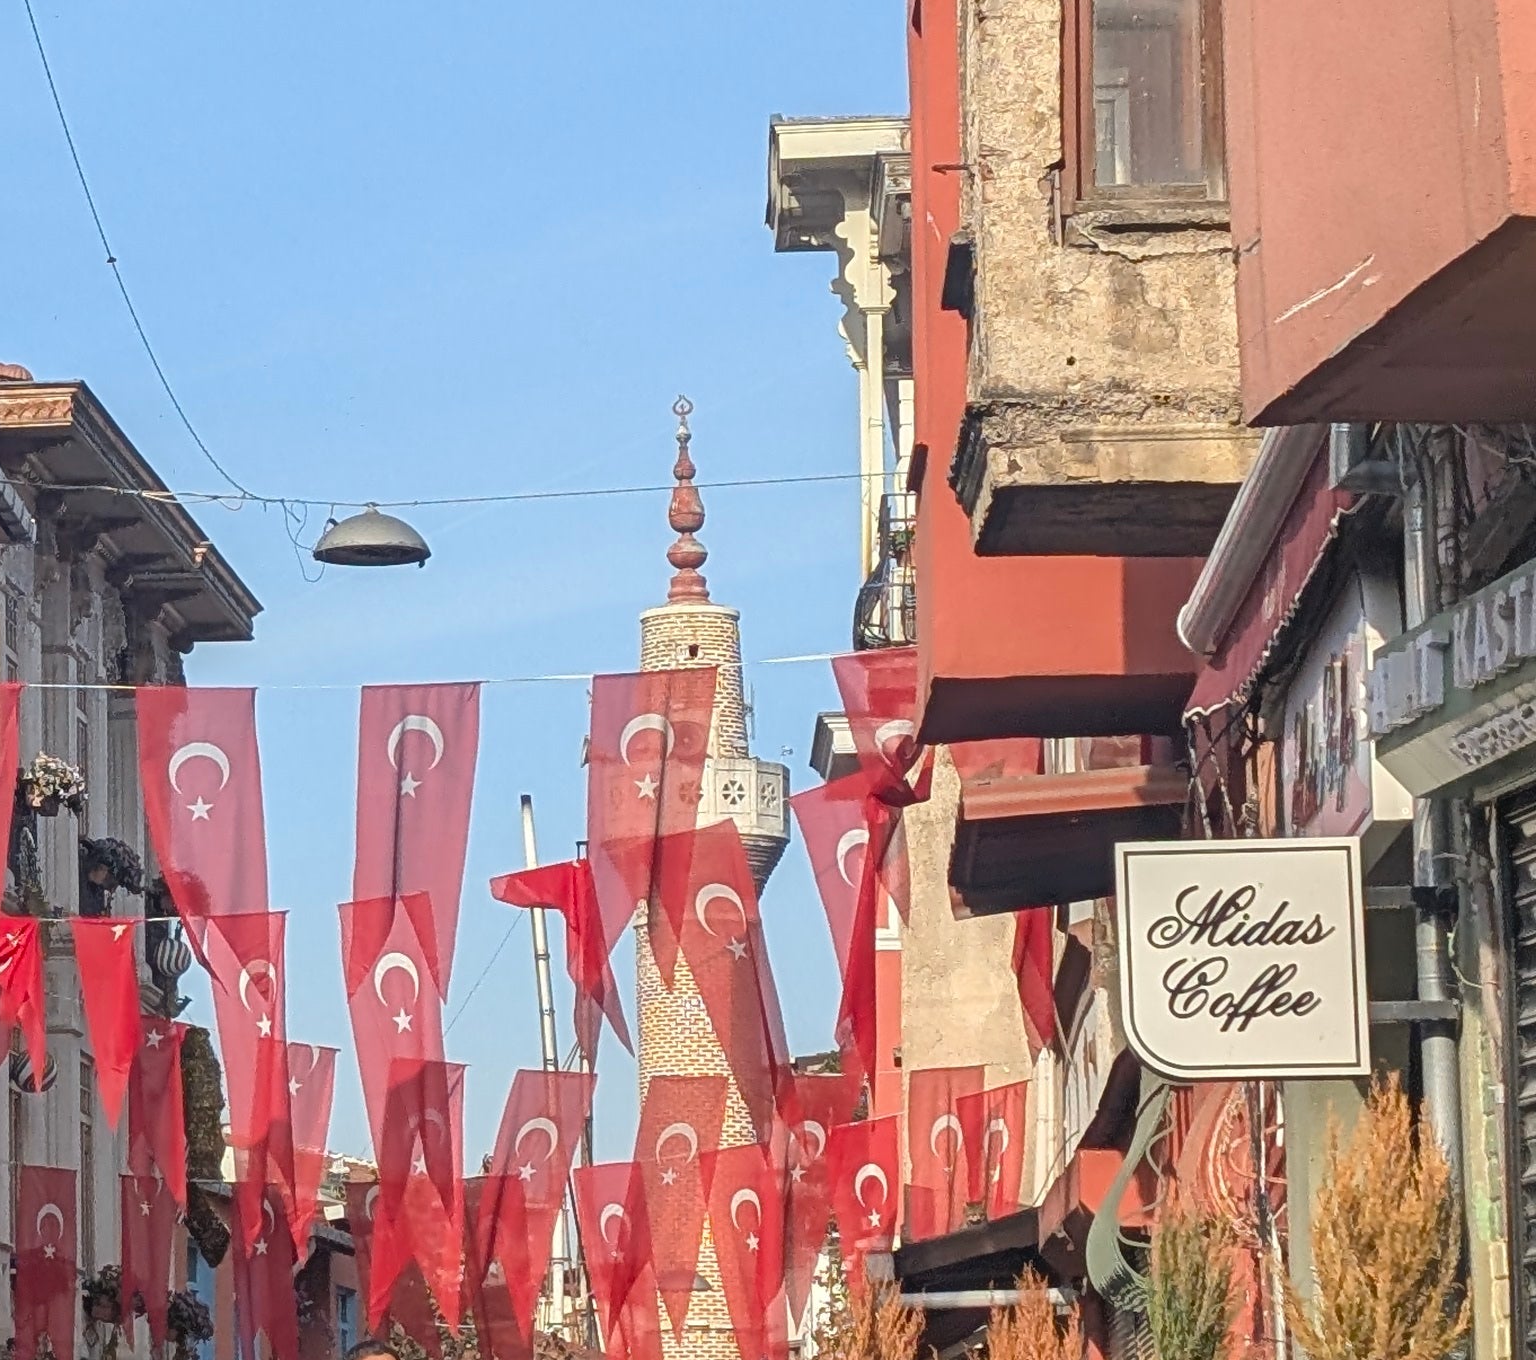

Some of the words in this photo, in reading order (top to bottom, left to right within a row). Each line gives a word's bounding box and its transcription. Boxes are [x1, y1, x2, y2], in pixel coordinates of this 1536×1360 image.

[1453, 570, 1536, 690] KAST
[1147, 885, 1336, 949] Midas
[1162, 956, 1322, 1033] Coffee
